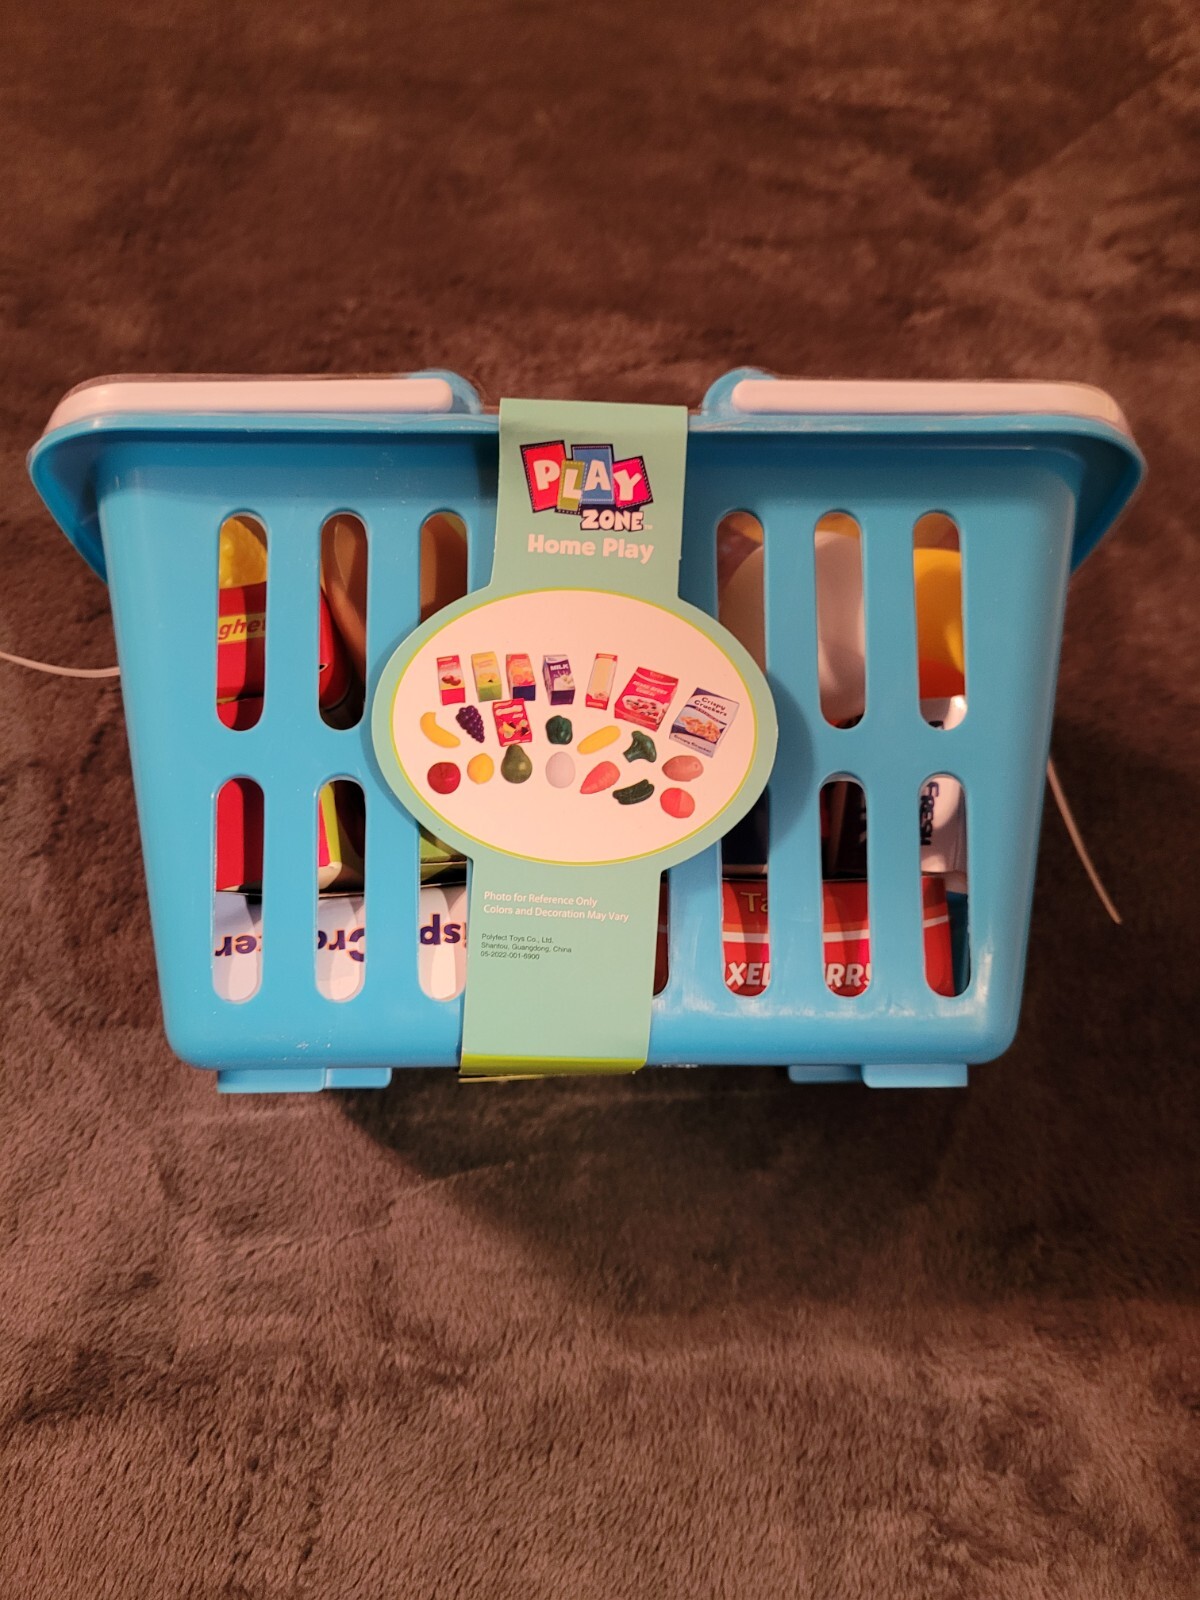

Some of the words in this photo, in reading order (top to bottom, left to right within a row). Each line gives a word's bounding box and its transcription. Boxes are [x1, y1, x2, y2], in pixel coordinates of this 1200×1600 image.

[533, 459, 642, 501] PLAY
[581, 509, 644, 532] ZONE
[527, 533, 596, 557] Home
[603, 537, 654, 564] Play
[550, 663, 569, 671] MILK
[694, 700, 728, 717] Crackers
[701, 697, 727, 711] Crispy
[483, 891, 512, 901] Photo
[513, 892, 527, 902] for
[528, 893, 574, 906] Reference
[575, 896, 598, 908] Only
[483, 904, 513, 914] Colors
[515, 906, 533, 916] and
[534, 907, 586, 919] Decoration
[587, 910, 607, 922] May
[608, 911, 629, 923] Vary
[481, 933, 508, 942] Polyfect
[509, 934, 525, 943] Toys
[541, 936, 554, 944] Ltd.
[481, 942, 509, 951] Shantou,
[511, 943, 551, 953] Guangdong,
[553, 945, 572, 953] China
